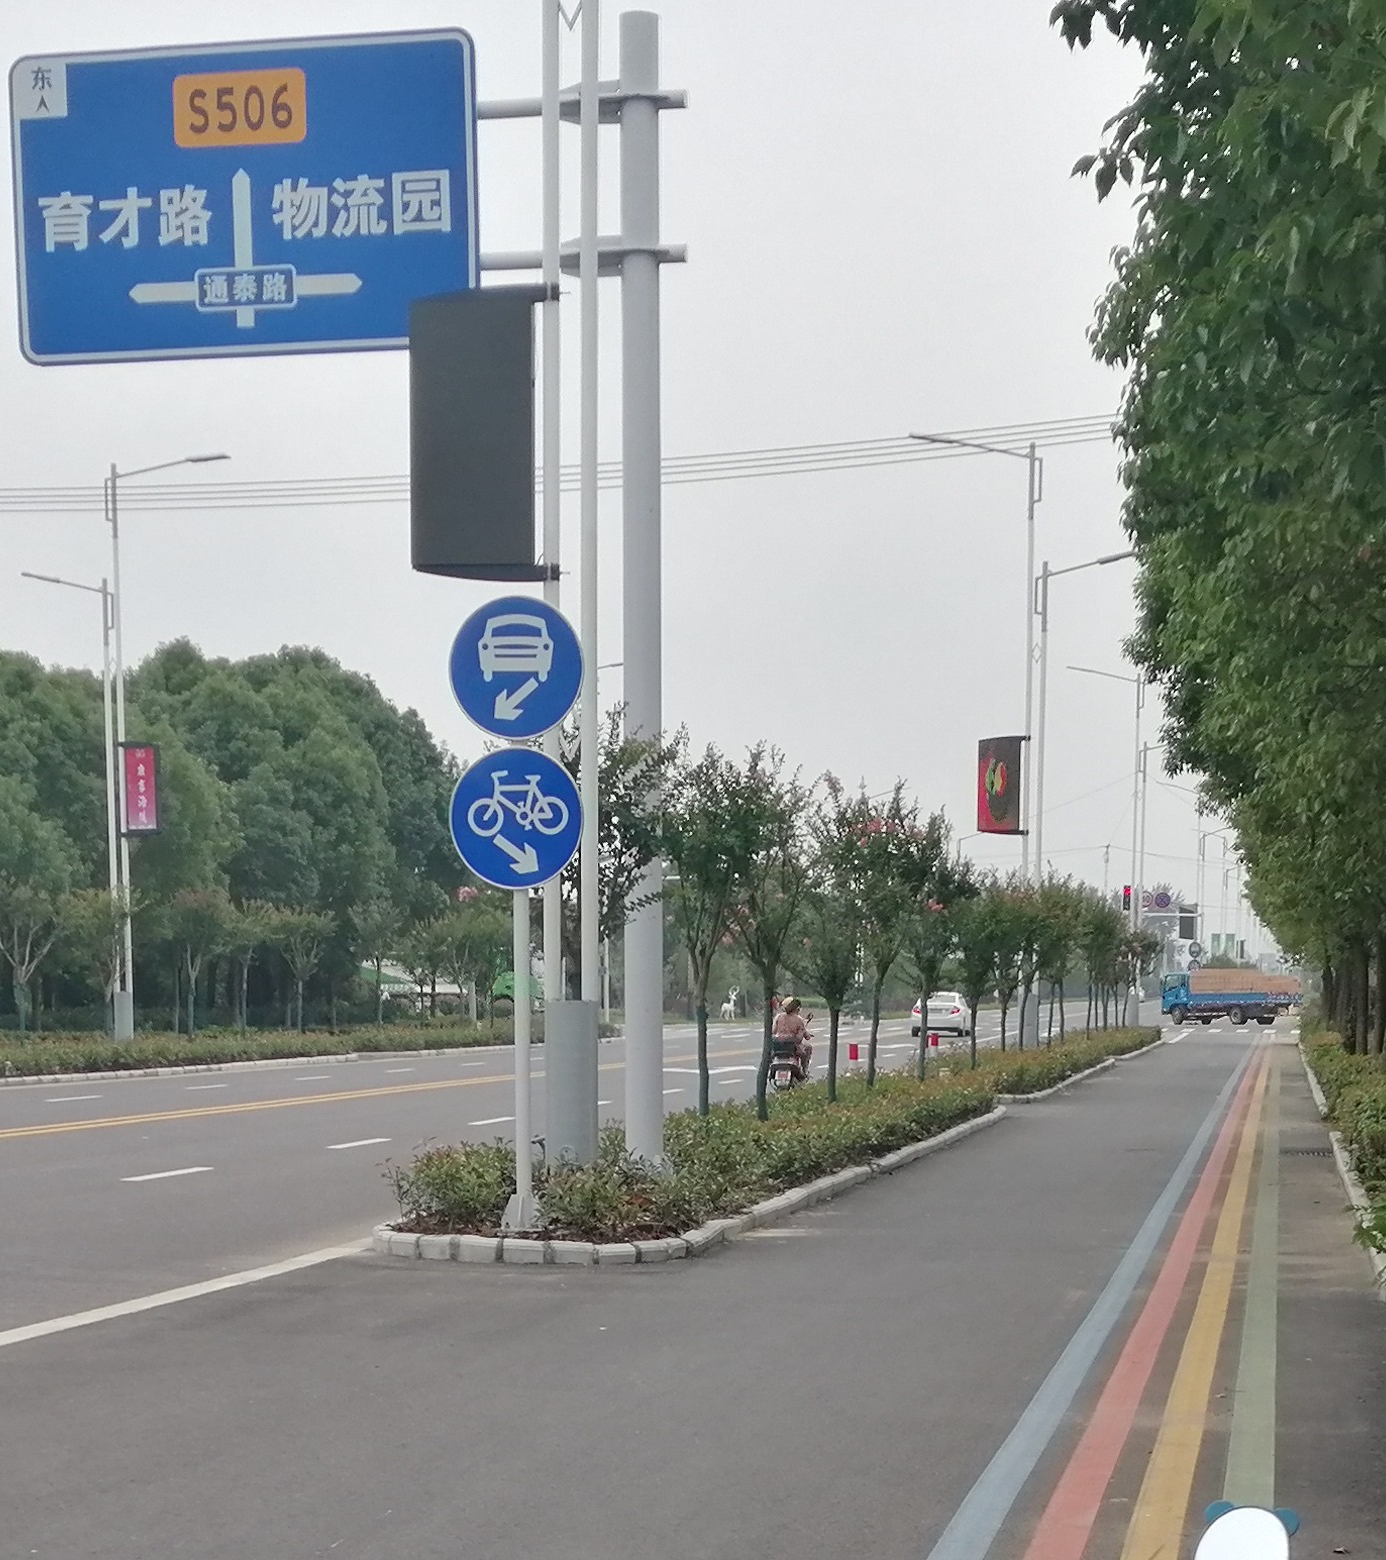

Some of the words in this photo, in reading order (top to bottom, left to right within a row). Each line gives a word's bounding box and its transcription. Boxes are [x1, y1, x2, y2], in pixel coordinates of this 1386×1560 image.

[30, 66, 52, 91] 东
[189, 84, 293, 134] S506
[38, 185, 213, 252] 育才路
[272, 169, 452, 239] 物流园
[203, 272, 288, 304] 通泰路
